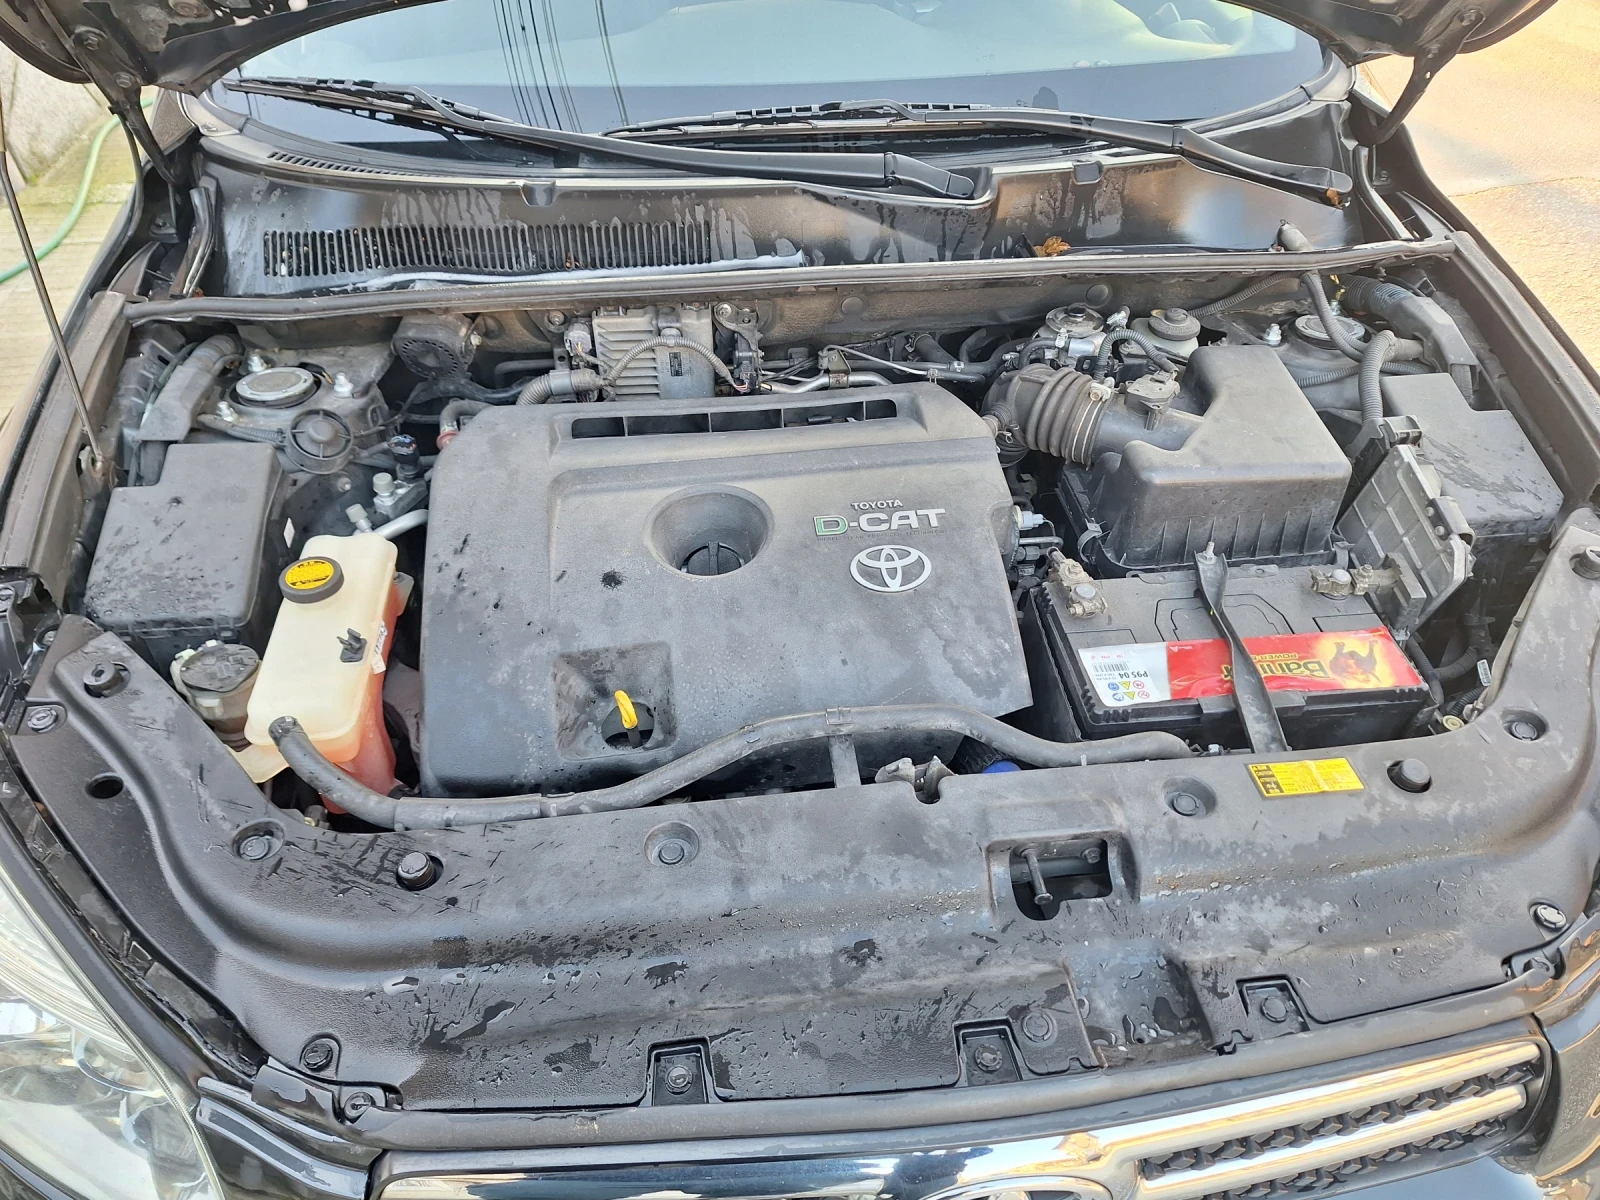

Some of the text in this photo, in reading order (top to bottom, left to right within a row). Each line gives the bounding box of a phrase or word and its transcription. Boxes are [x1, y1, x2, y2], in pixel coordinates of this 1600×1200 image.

[851, 499, 903, 510] TOYOTA
[813, 508, 946, 536] D-CAT
[1260, 653, 1297, 661] POWER
[1118, 671, 1130, 679] 04
